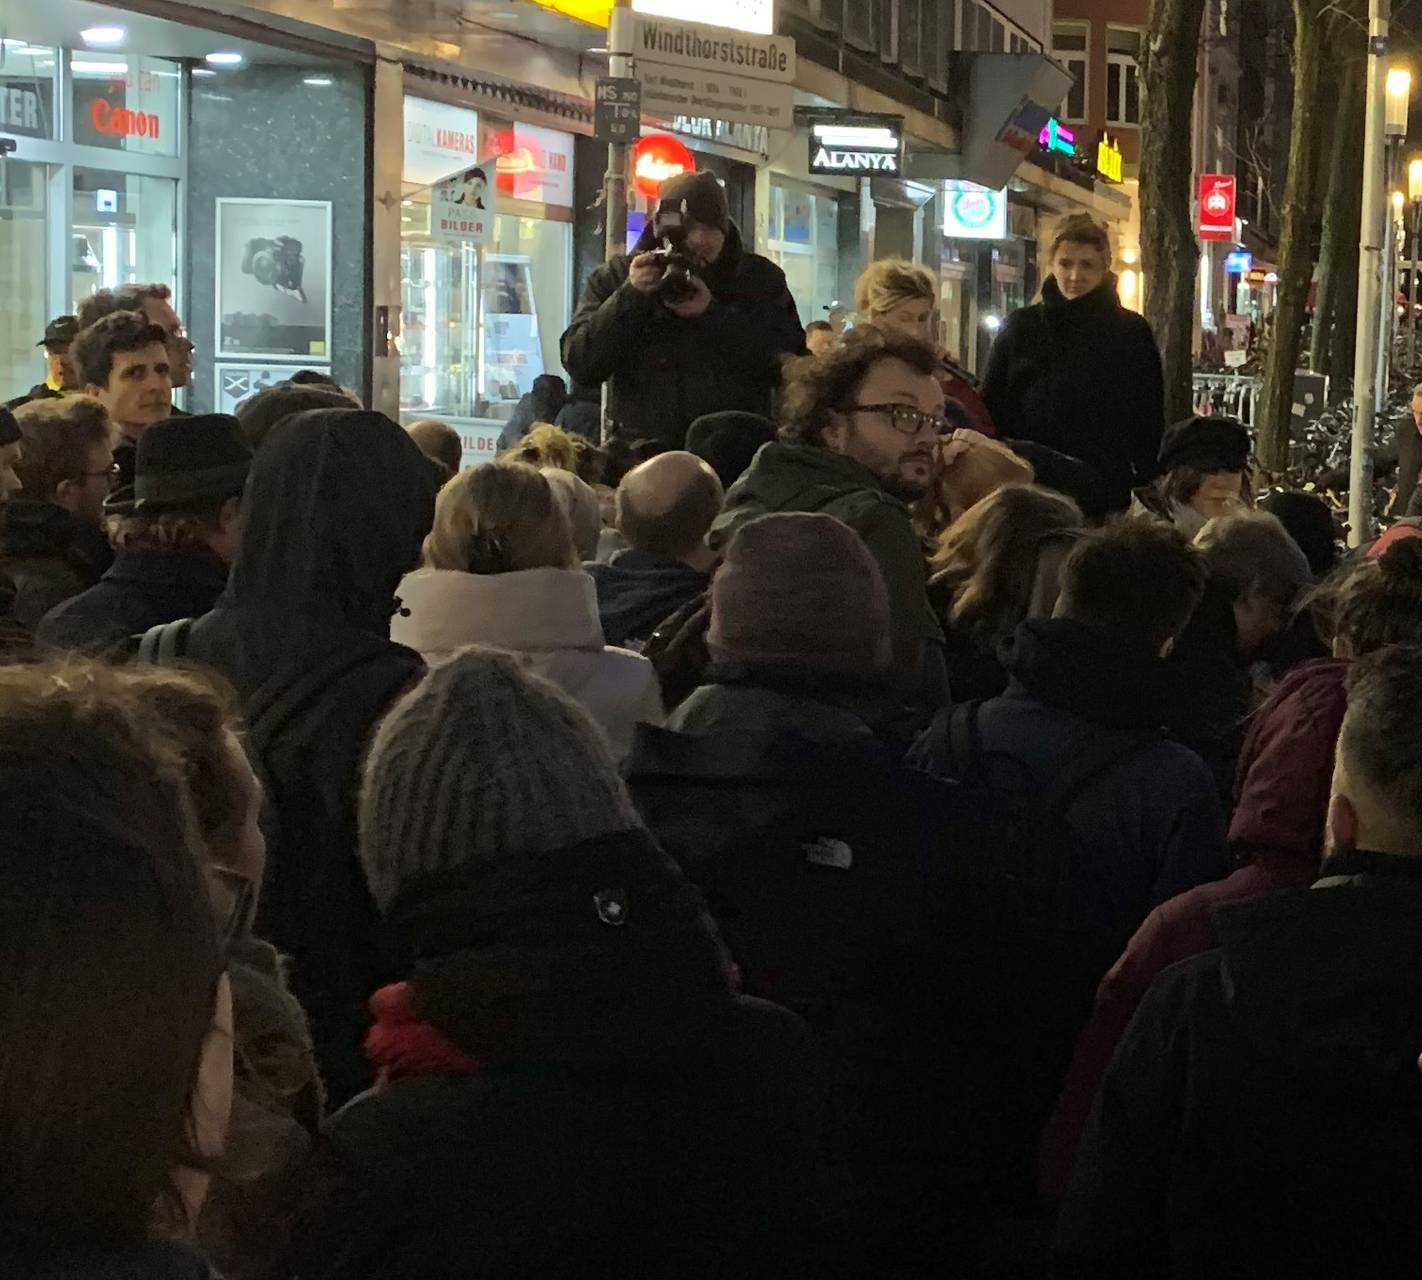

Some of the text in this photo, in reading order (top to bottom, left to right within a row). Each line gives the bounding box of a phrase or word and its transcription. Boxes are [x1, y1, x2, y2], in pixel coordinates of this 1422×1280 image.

[642, 22, 788, 72] Windthorststraße
[90, 97, 159, 139] Canon
[812, 146, 897, 171] ALANYA
[440, 219, 483, 233] BILDER
